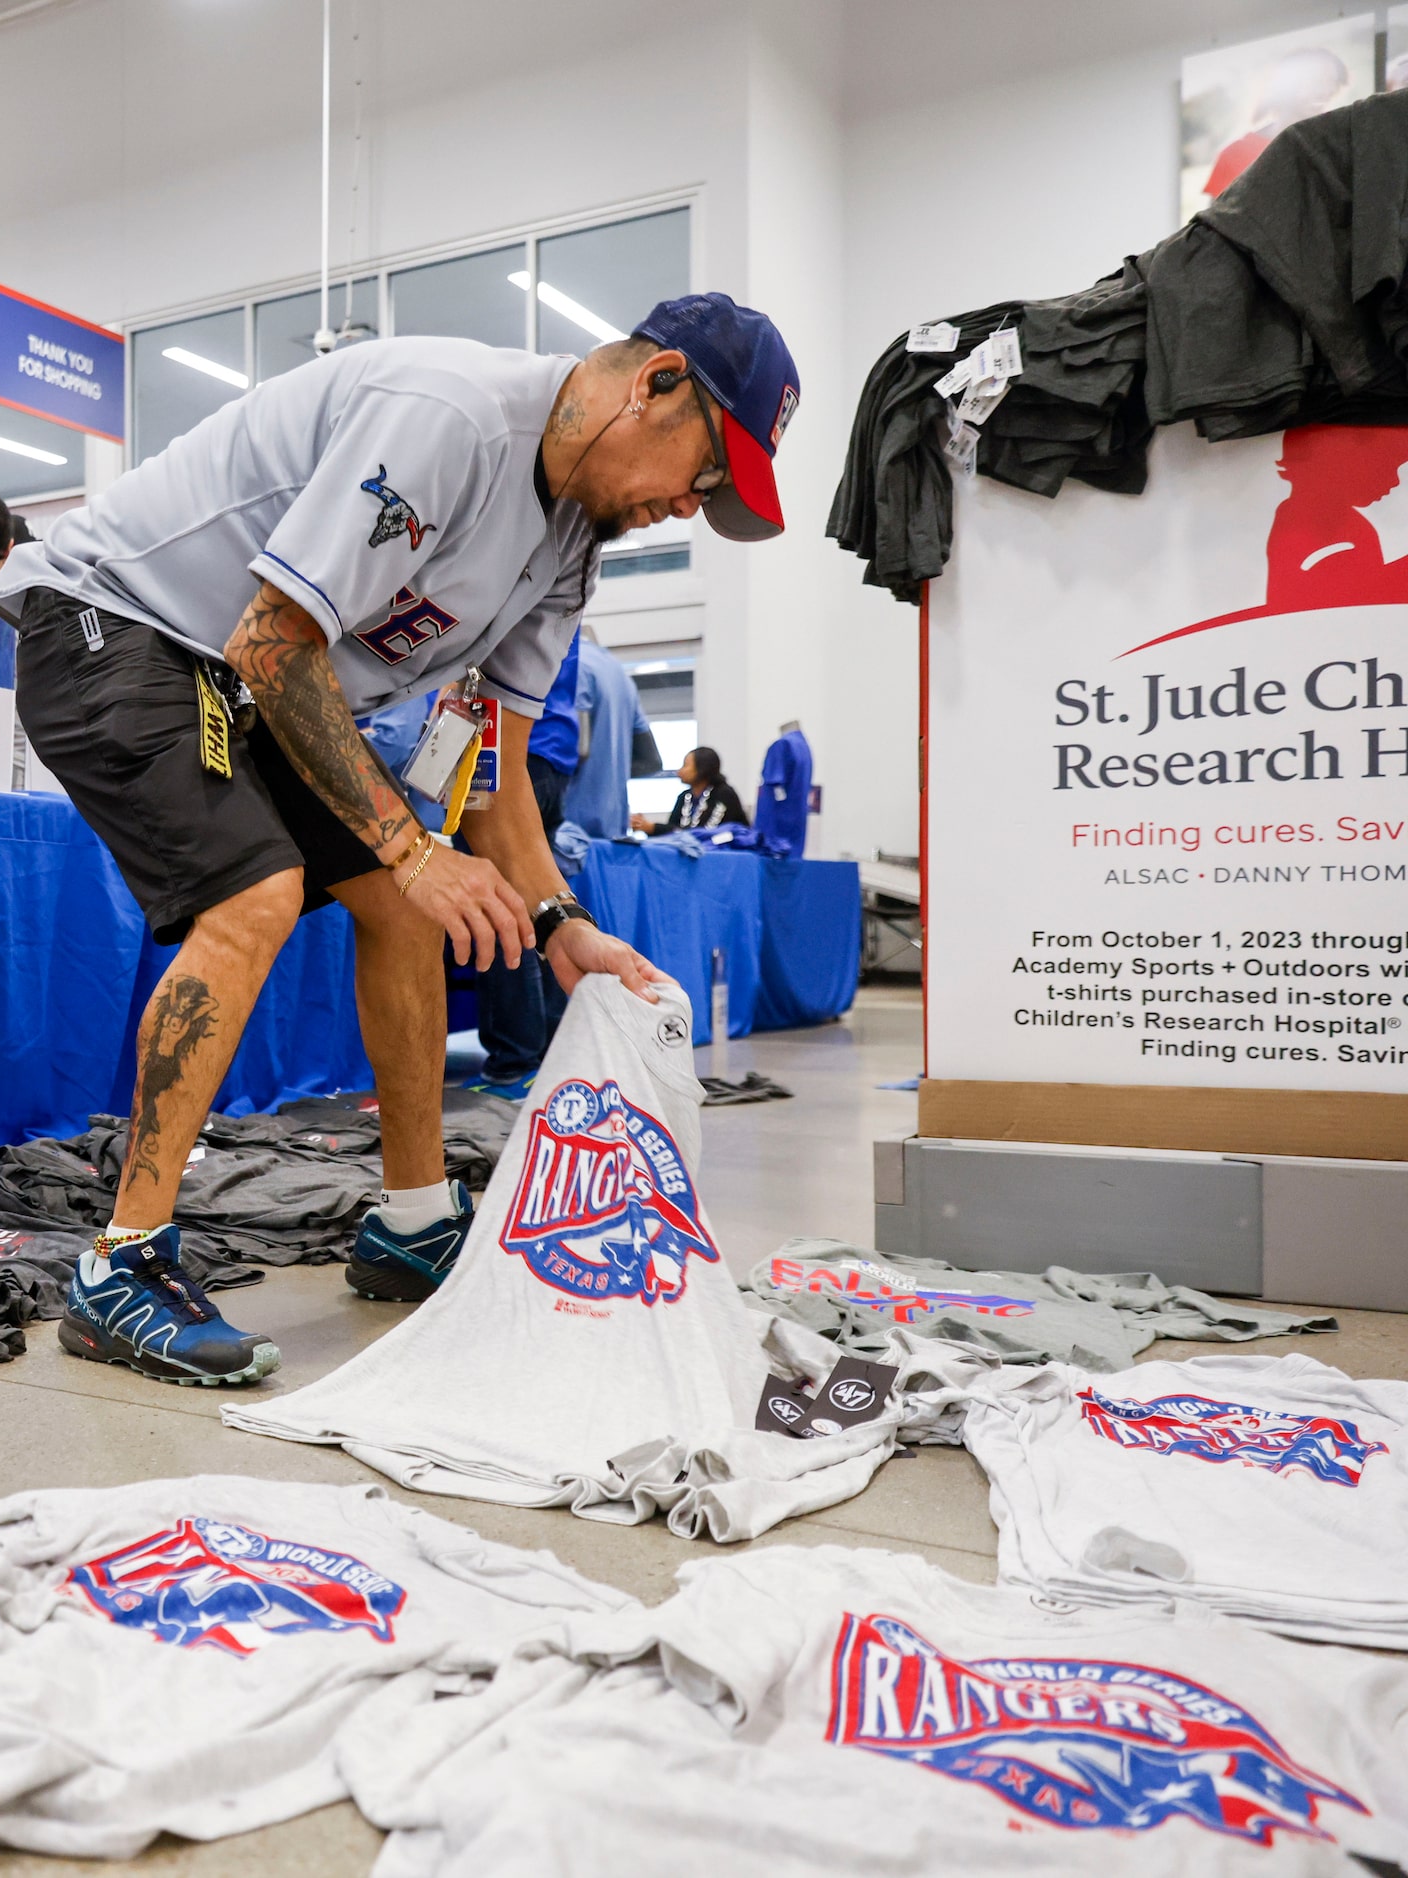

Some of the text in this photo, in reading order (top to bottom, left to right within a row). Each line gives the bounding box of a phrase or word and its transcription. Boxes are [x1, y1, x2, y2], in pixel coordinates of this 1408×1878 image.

[27, 334, 94, 375] THANK YOU
[18, 355, 102, 401] FOR SHOPPING
[1054, 679, 1129, 726] St.
[1138, 667, 1286, 736] Jude
[1052, 730, 1344, 790] Research
[1072, 822, 1201, 852] Finding
[1214, 820, 1324, 845] cures.
[1103, 868, 1190, 885] ALSAC
[1214, 866, 1311, 884] DANNY
[1032, 931, 1093, 949] From
[1101, 931, 1202, 949] October
[1211, 931, 1233, 951] 1,
[1241, 931, 1302, 949] 2023
[1012, 957, 1123, 979] Academy
[1132, 958, 1214, 979] Sports
[1221, 961, 1237, 974] +
[1244, 958, 1370, 979] Outdoors
[1047, 984, 1133, 1001] t-shirts
[1142, 985, 1279, 1006] purchased
[1287, 987, 1393, 1007] in-store
[1014, 1009, 1135, 1029] Children's
[1144, 1012, 1265, 1032] Research
[1141, 1038, 1237, 1063] Finding
[1246, 1042, 1328, 1062] cures.
[637, 1131, 689, 1196] SERIES
[543, 1250, 610, 1292] TEXAS
[267, 1541, 346, 1579] WORLD
[975, 1661, 1103, 1682] WORLD
[857, 1640, 1189, 1745] RANGERS
